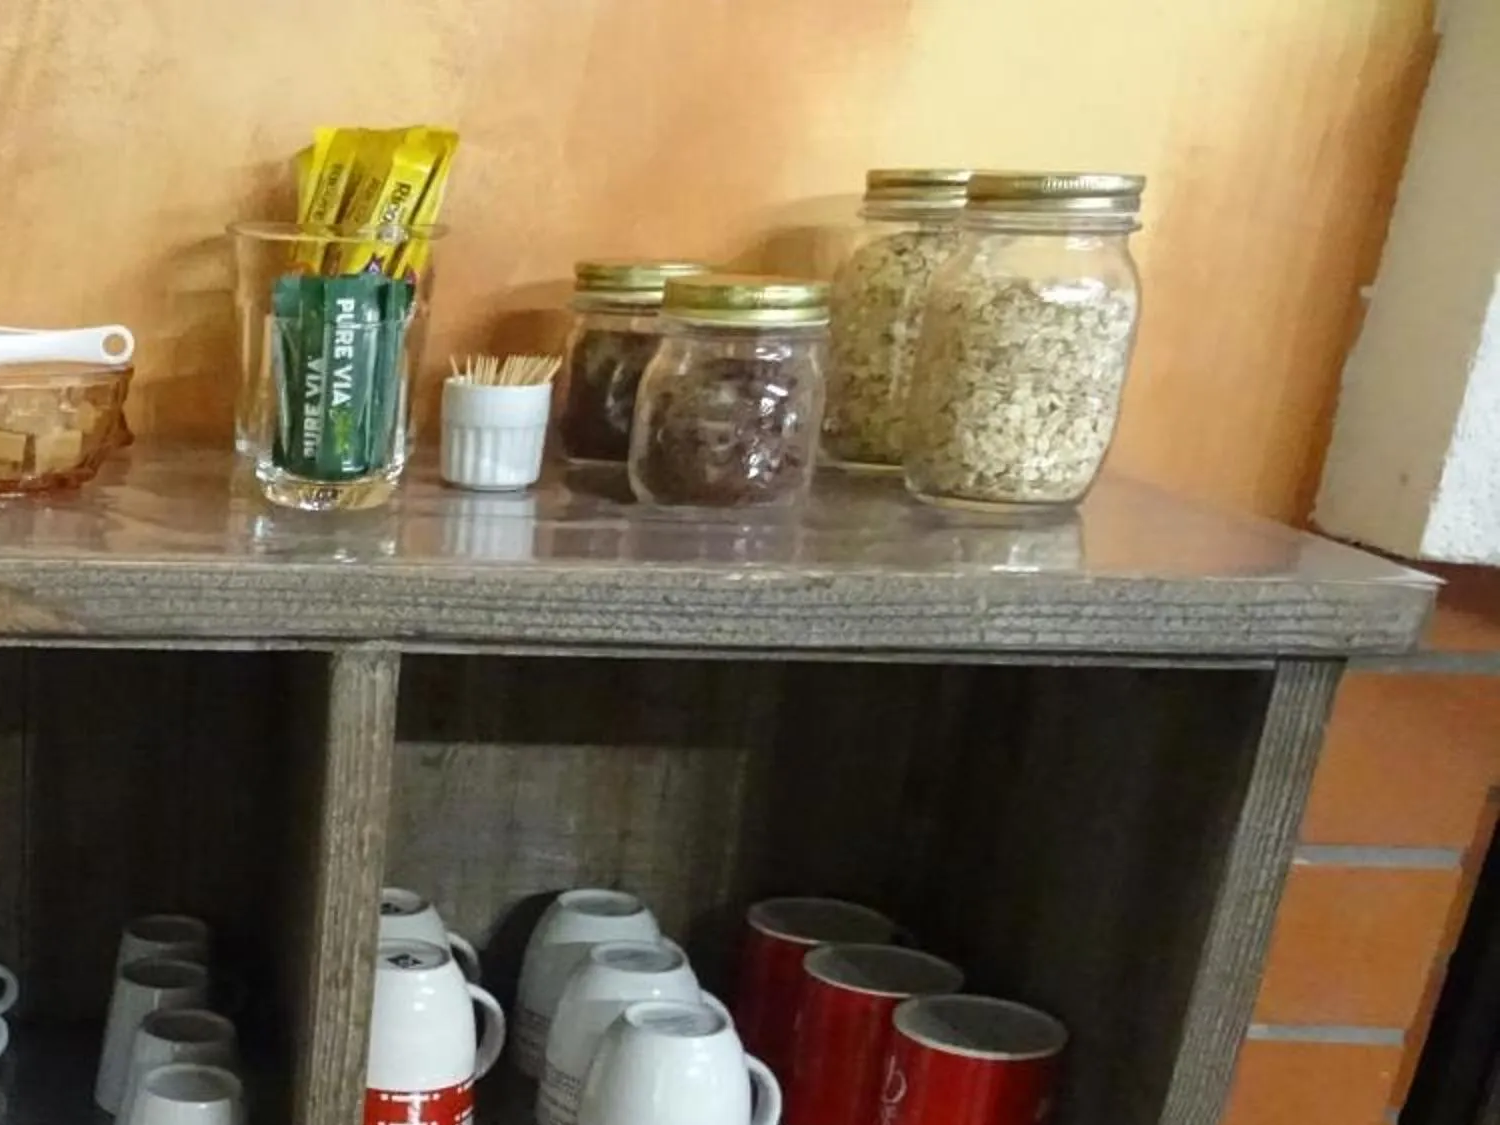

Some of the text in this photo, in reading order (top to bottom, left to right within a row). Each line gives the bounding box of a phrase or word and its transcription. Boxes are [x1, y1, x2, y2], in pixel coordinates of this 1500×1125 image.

[305, 357, 326, 399] VIA
[332, 297, 356, 407] PURE VIA
